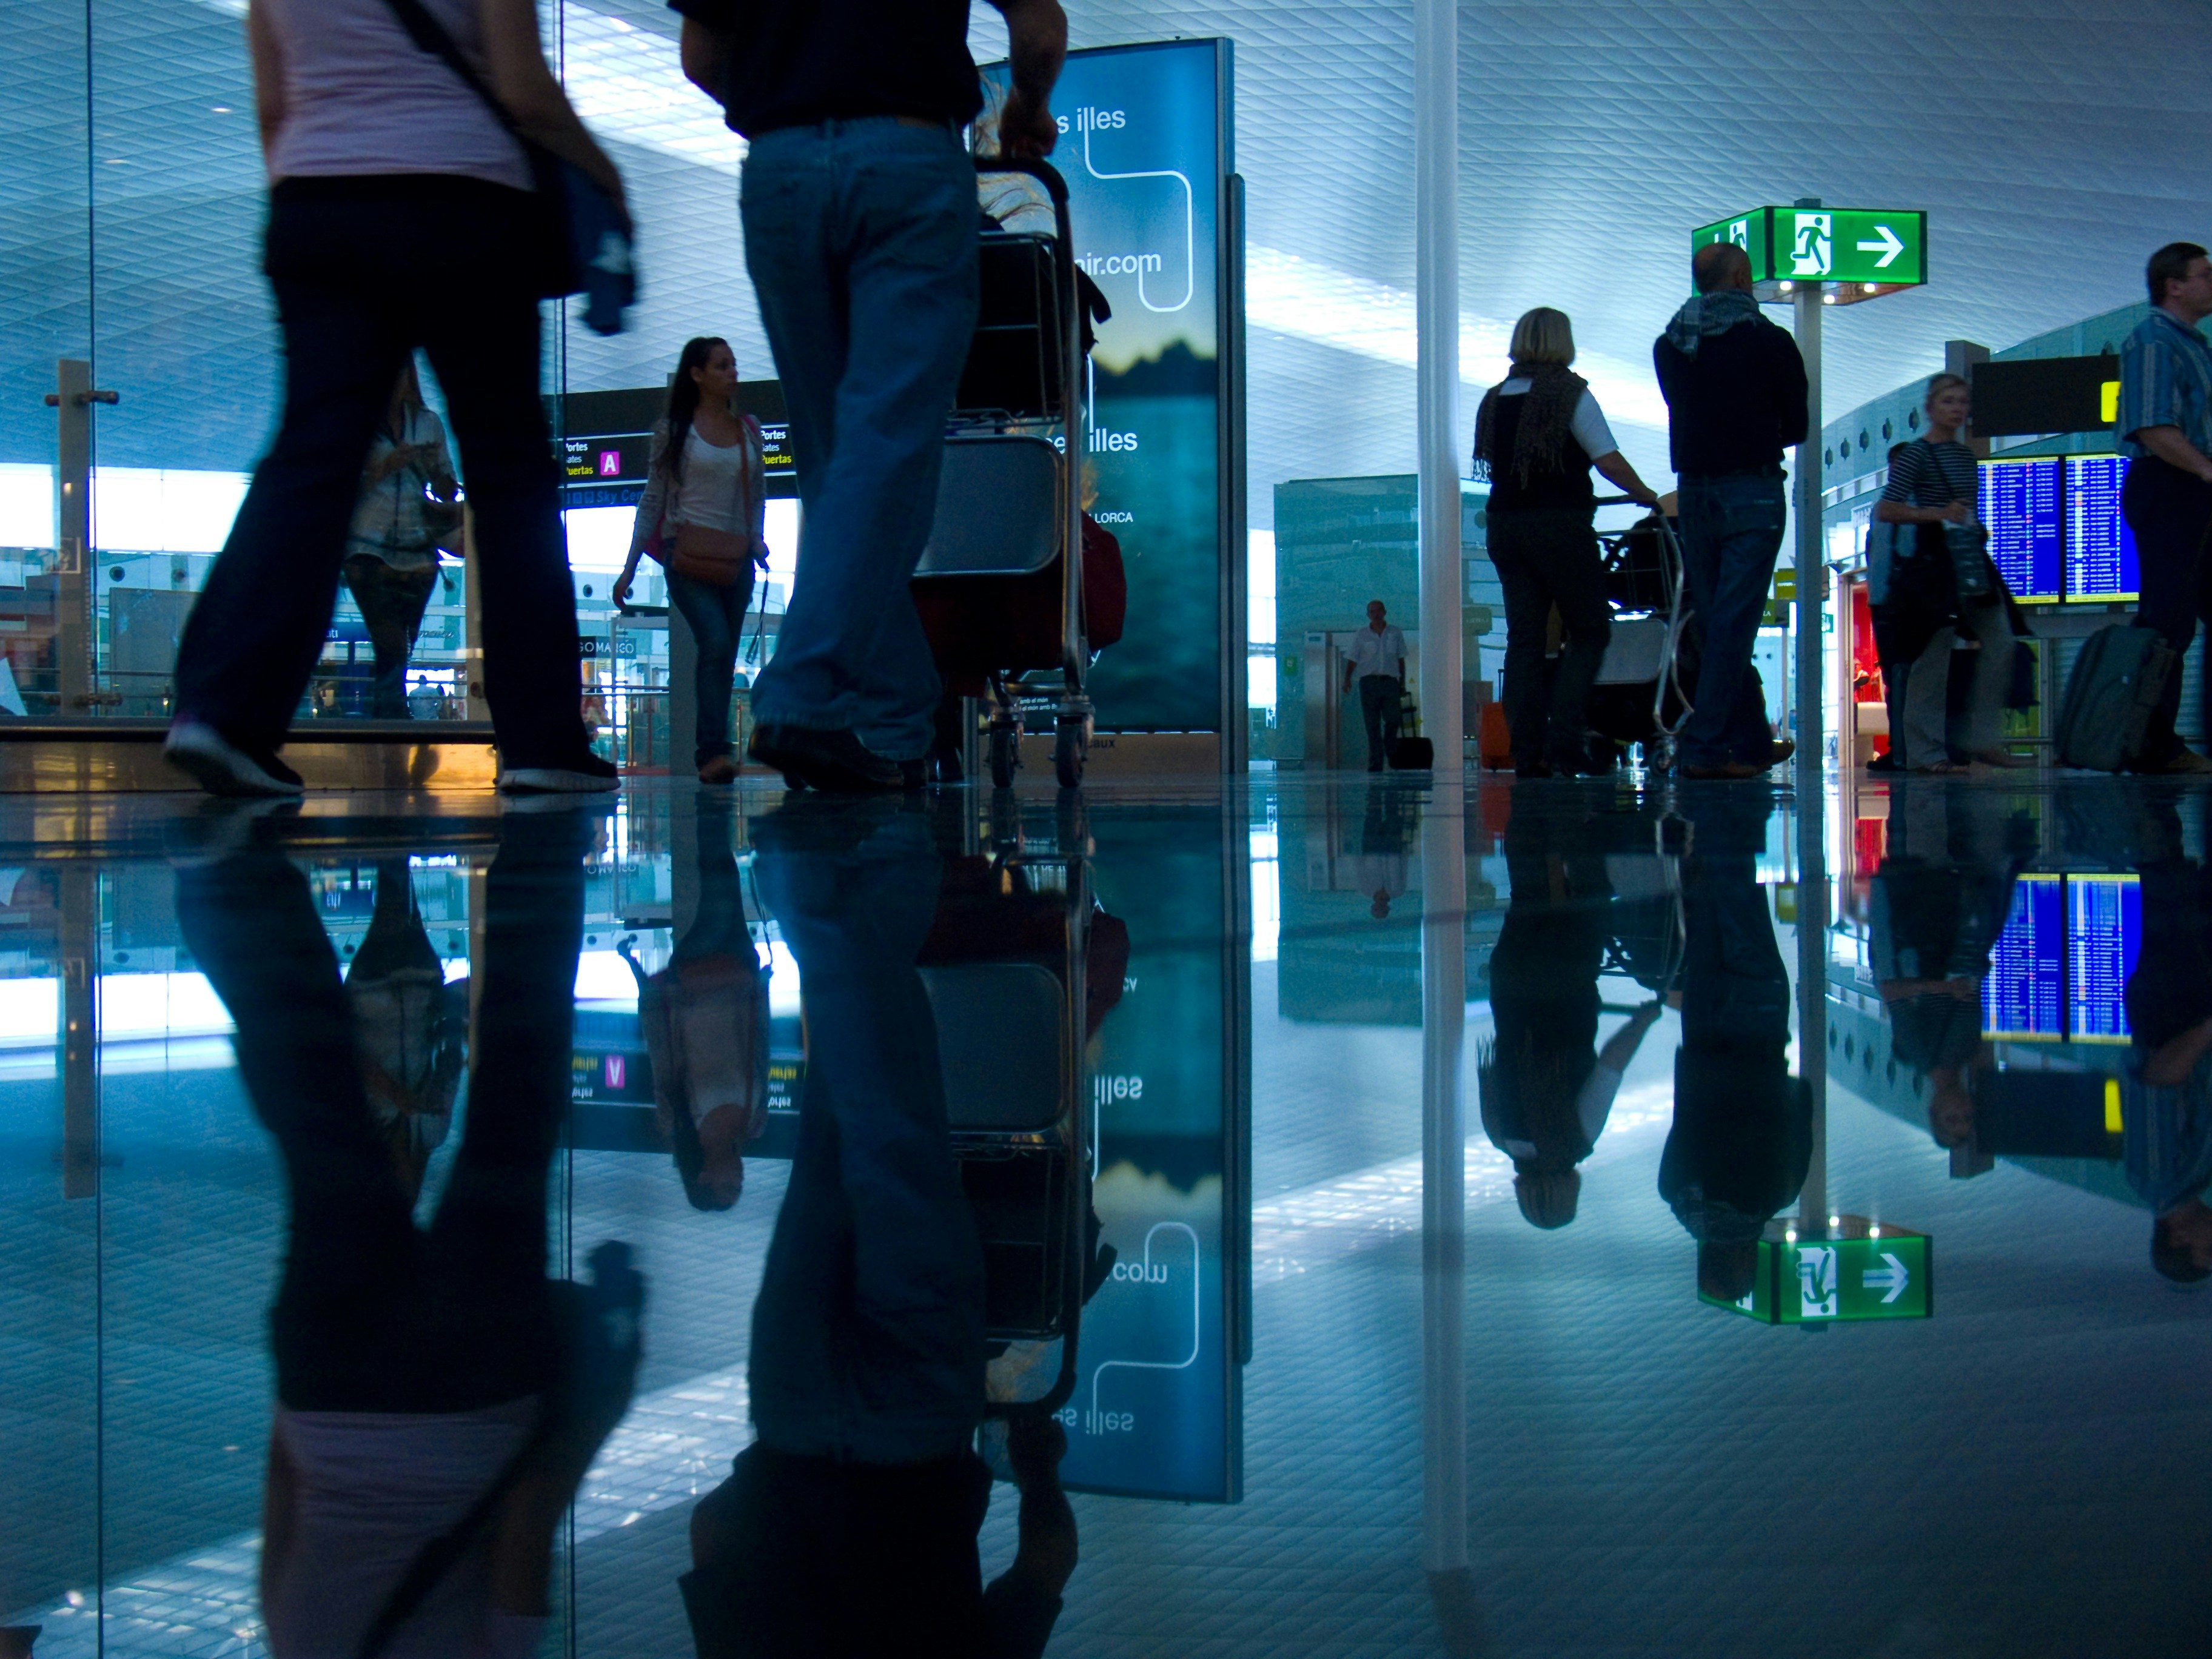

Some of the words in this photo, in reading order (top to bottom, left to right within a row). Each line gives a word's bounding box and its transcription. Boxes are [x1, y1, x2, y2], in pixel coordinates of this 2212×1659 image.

[1056, 115, 1069, 134] s
[1076, 107, 1126, 132] illes
[1074, 252, 1161, 276] air.com
[1089, 427, 1138, 452] illes
[566, 442, 588, 452] ortes
[566, 455, 582, 464] ates
[603, 454, 616, 472] A
[566, 466, 594, 476] uertas
[1094, 512, 1134, 523] LORCA
